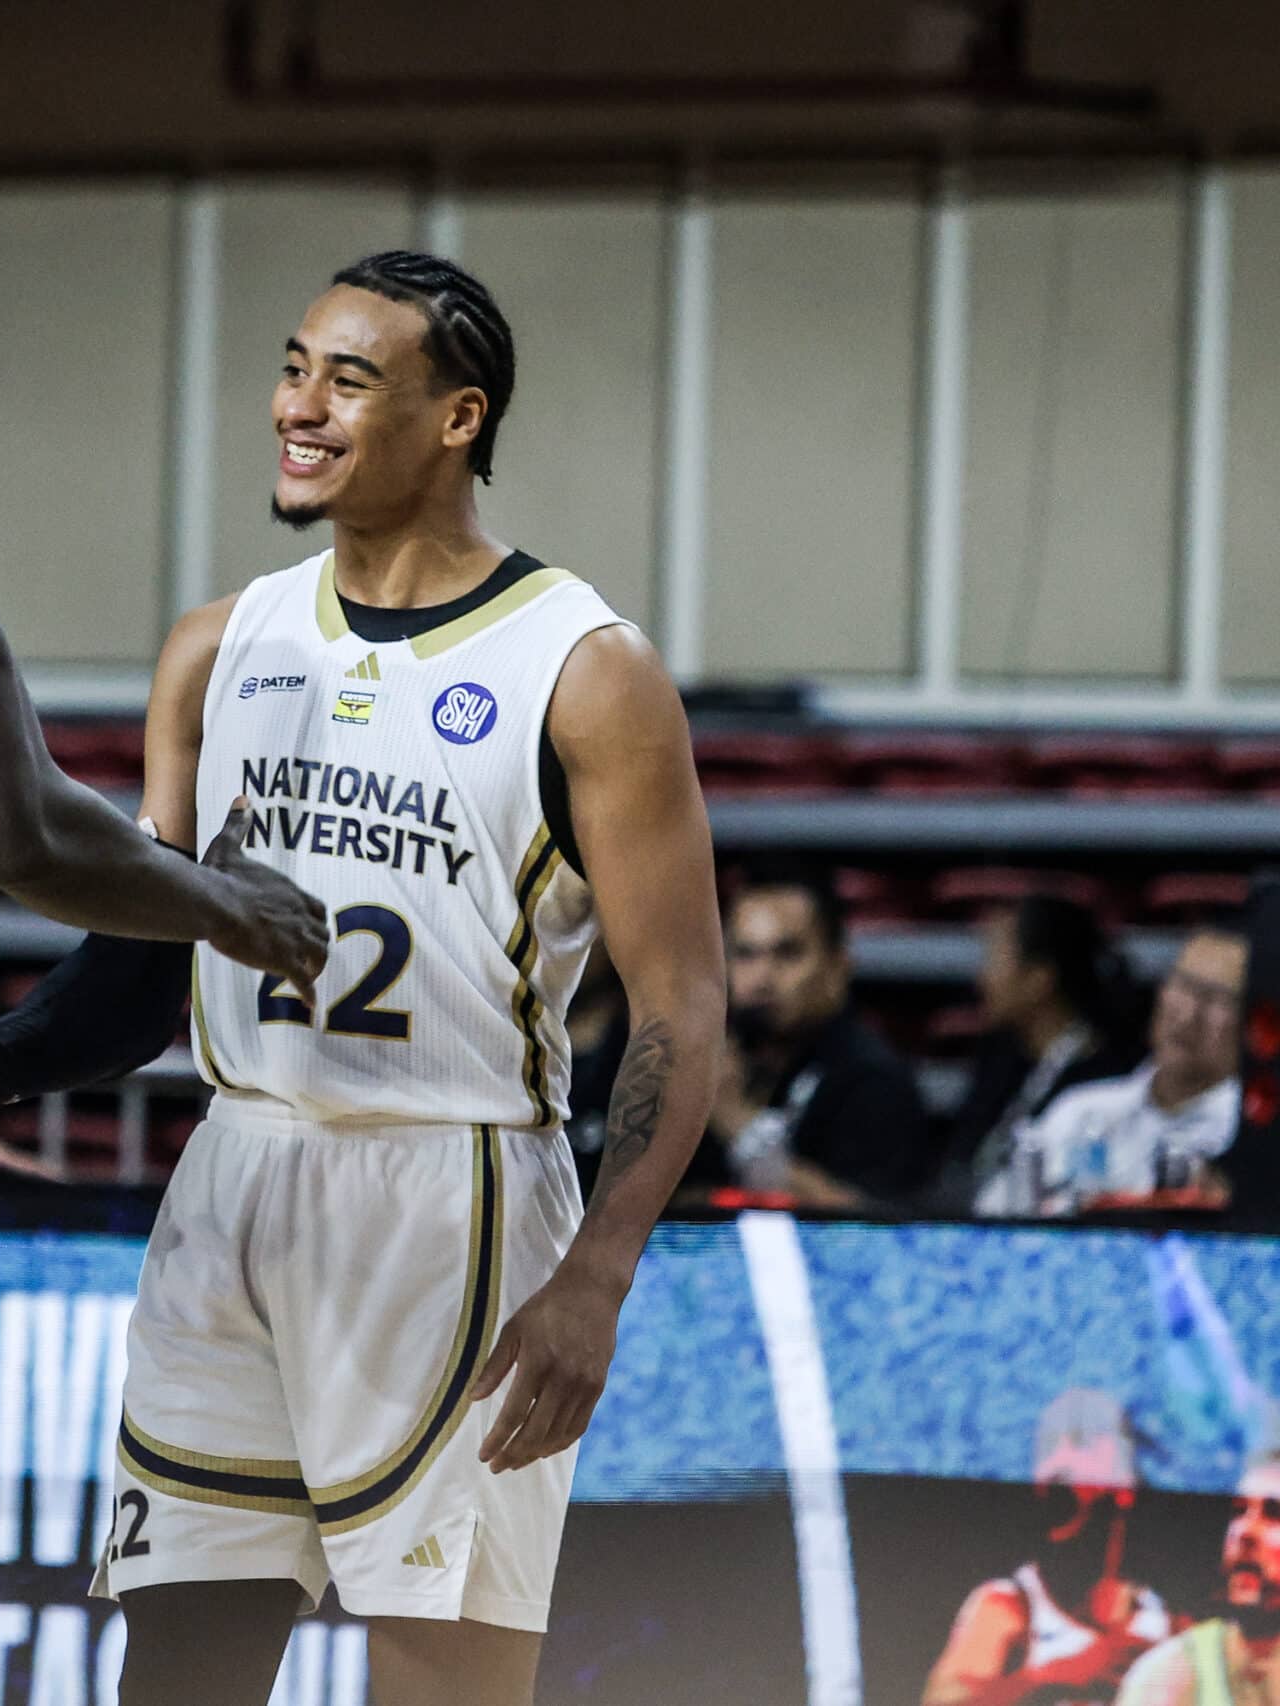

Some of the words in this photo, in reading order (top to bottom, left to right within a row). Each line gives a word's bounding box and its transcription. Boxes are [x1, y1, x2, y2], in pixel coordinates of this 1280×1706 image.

[260, 675, 306, 688] DATEM
[242, 756, 458, 833] NATIONAL
[246, 806, 474, 886] NVERSITY
[110, 1489, 151, 1564] 2
